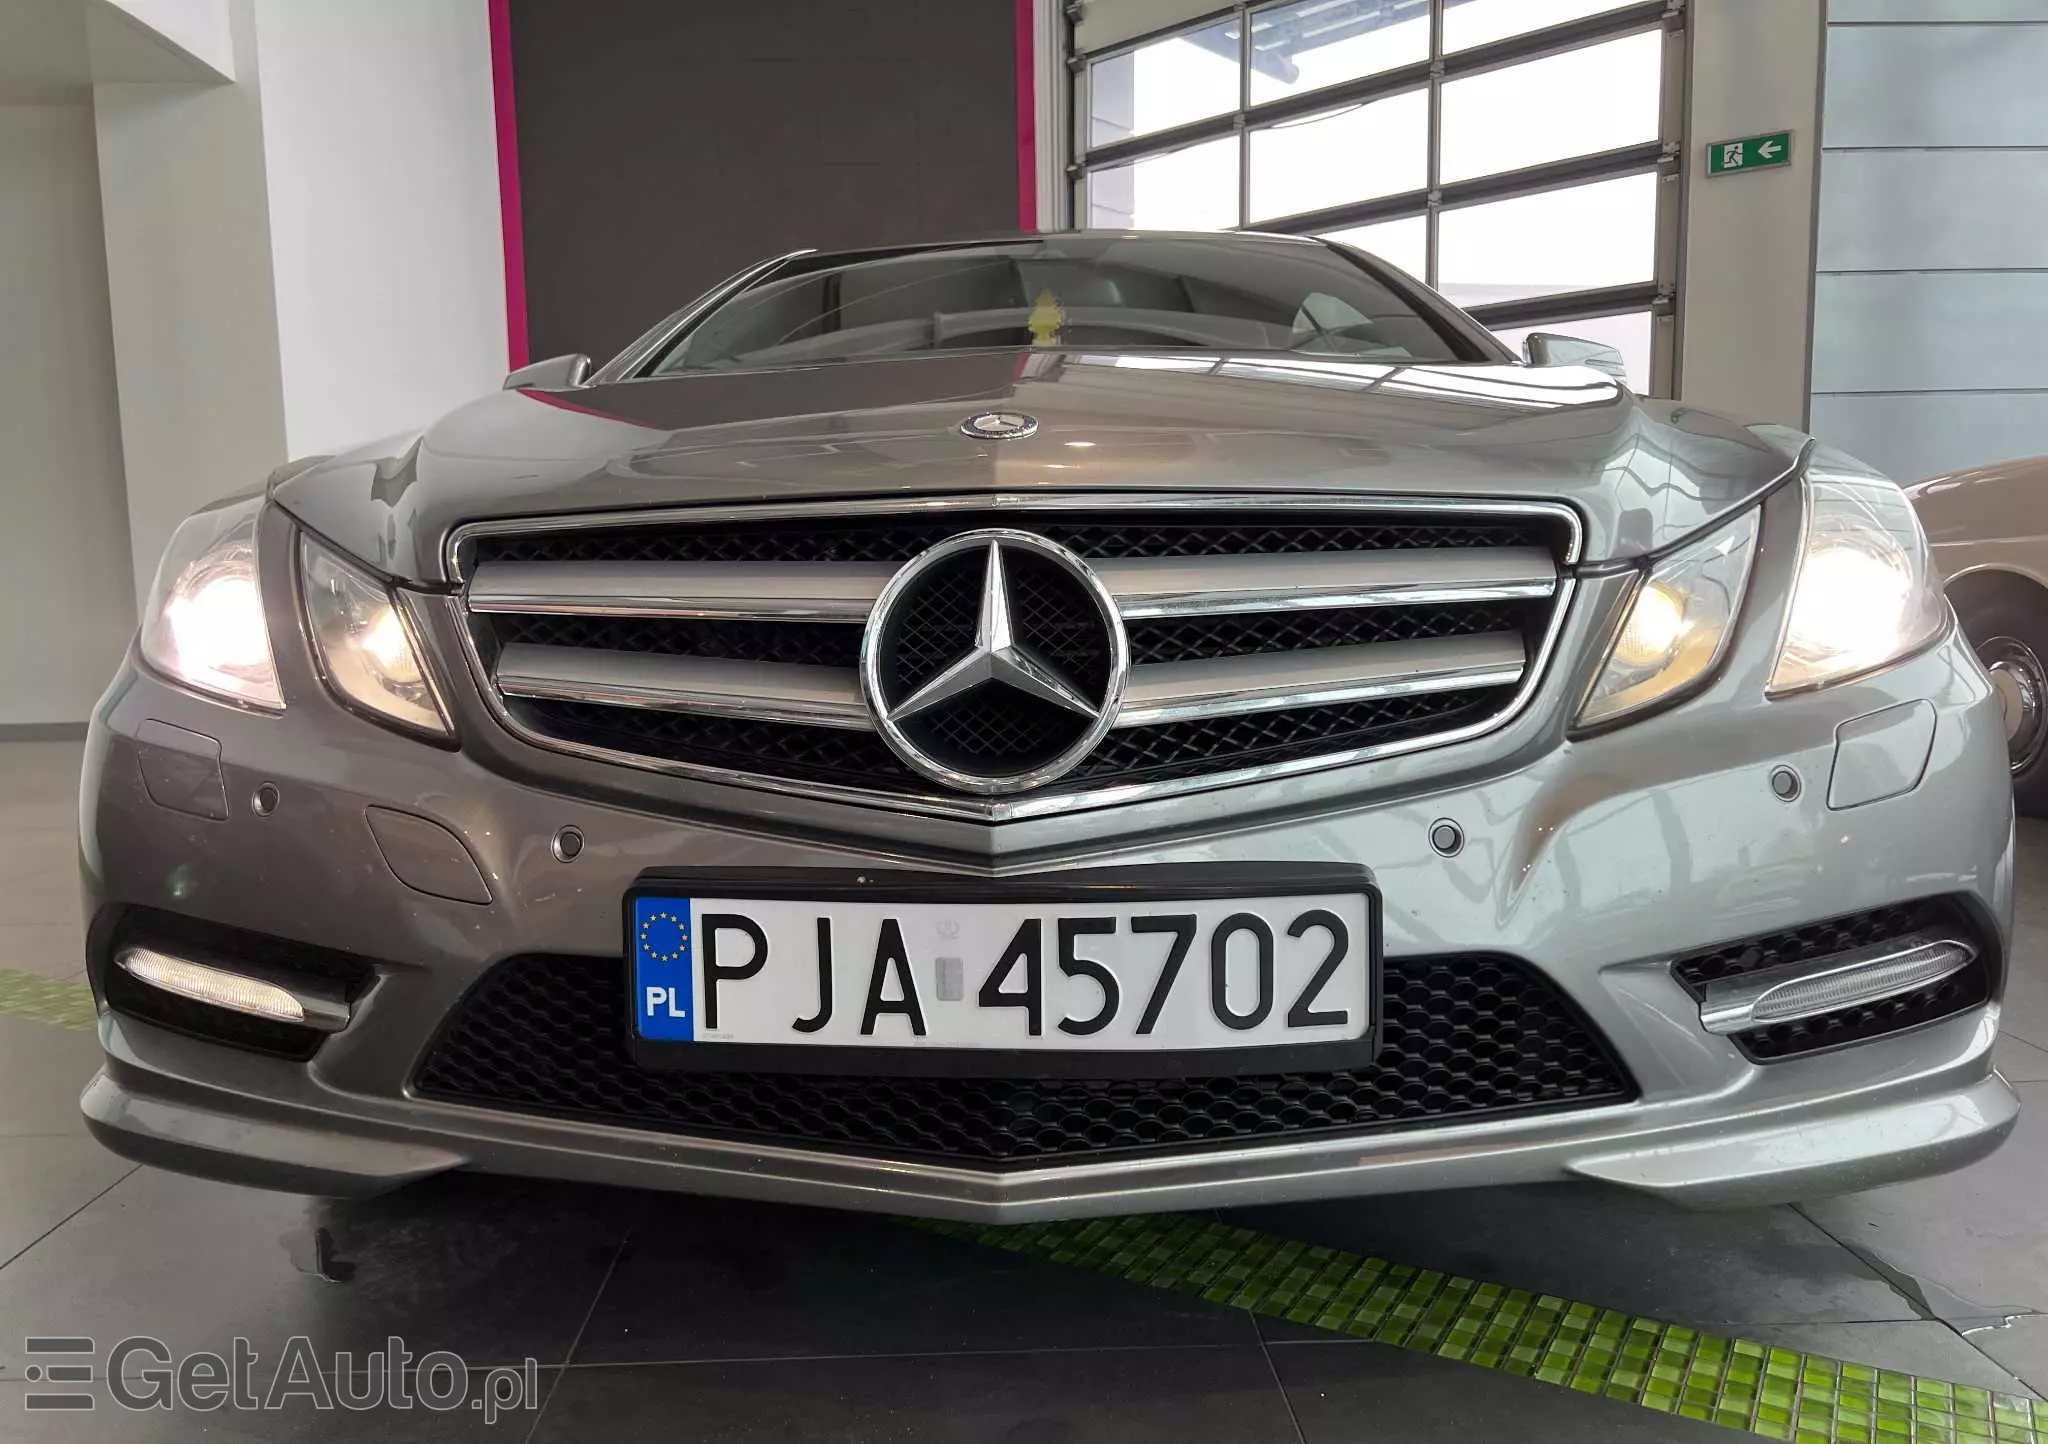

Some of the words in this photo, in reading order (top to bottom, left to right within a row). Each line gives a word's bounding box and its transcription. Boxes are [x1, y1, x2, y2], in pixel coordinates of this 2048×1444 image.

[646, 986, 686, 1018] PL
[702, 913, 927, 1036] PJA
[979, 910, 1349, 1037] 45702
